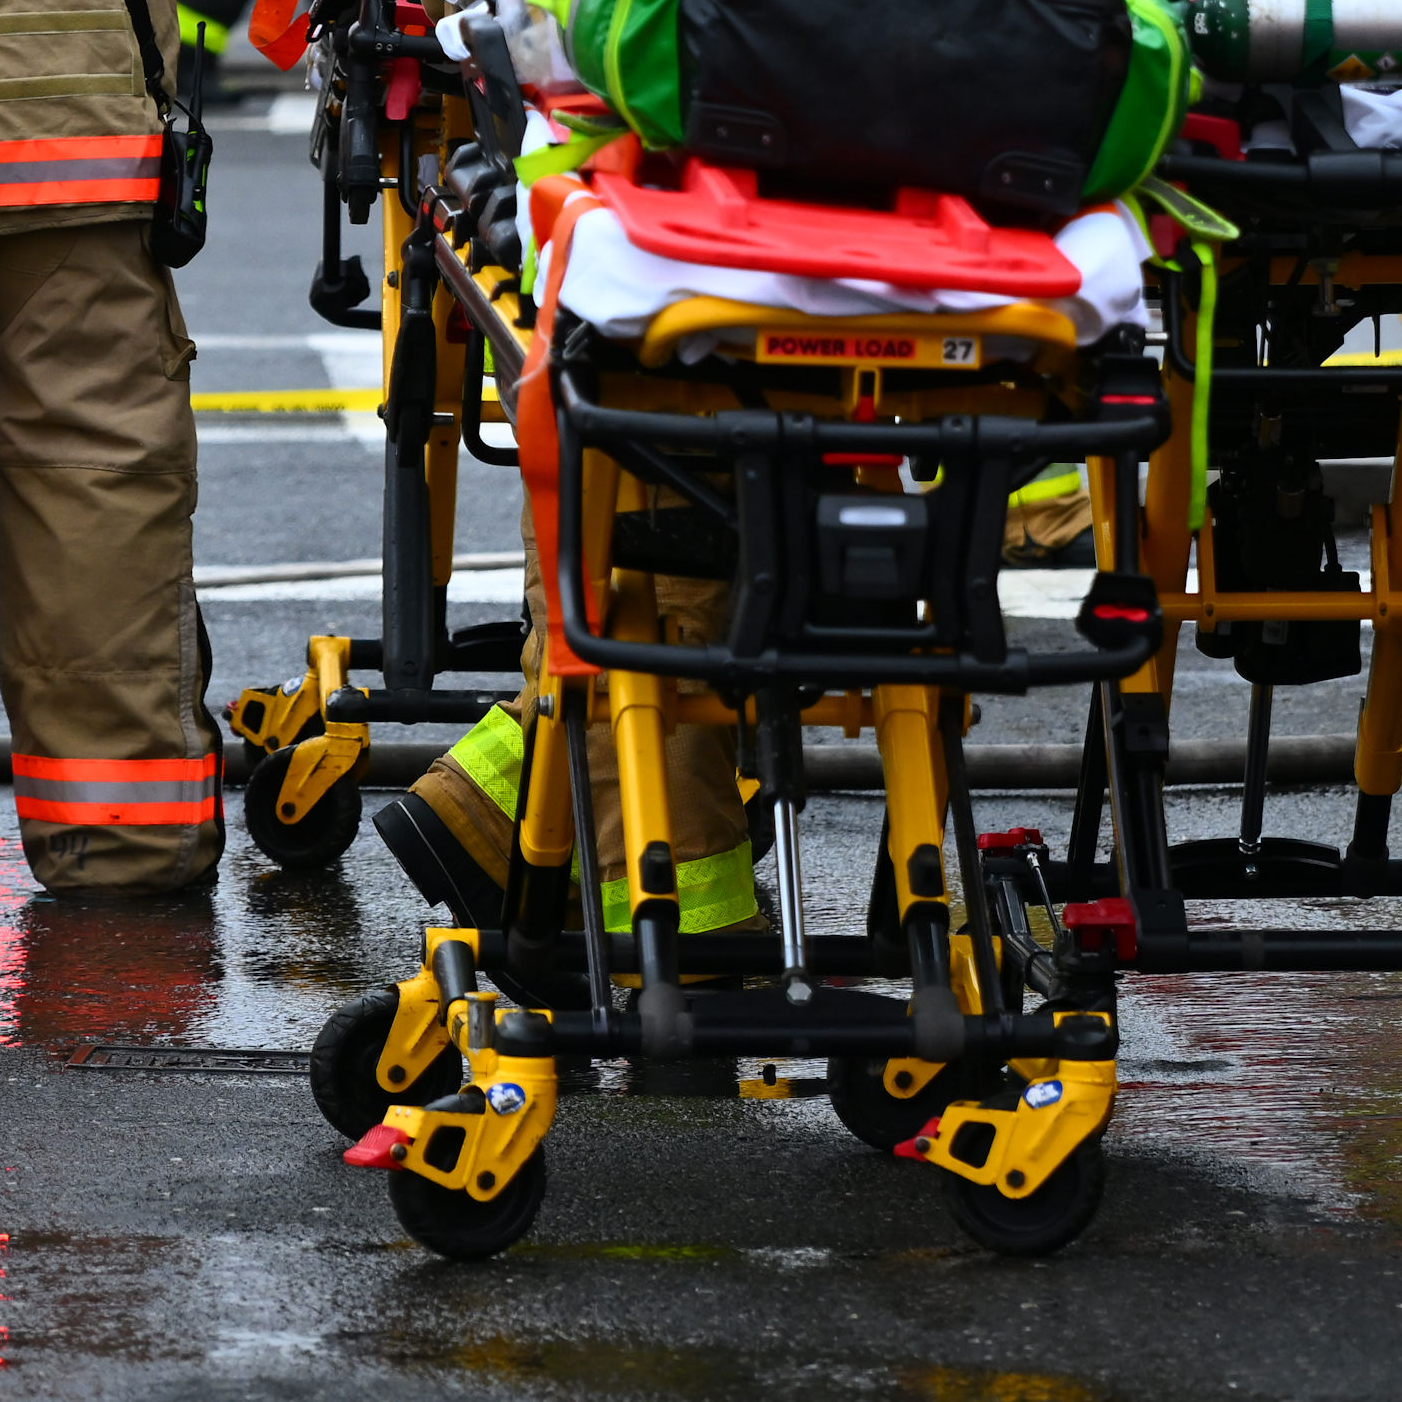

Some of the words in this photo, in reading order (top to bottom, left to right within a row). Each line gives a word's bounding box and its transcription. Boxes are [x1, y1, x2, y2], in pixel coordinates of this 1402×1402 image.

[768, 337, 845, 356] POWER
[855, 339, 913, 358] LOAD
[943, 340, 974, 360] 27
